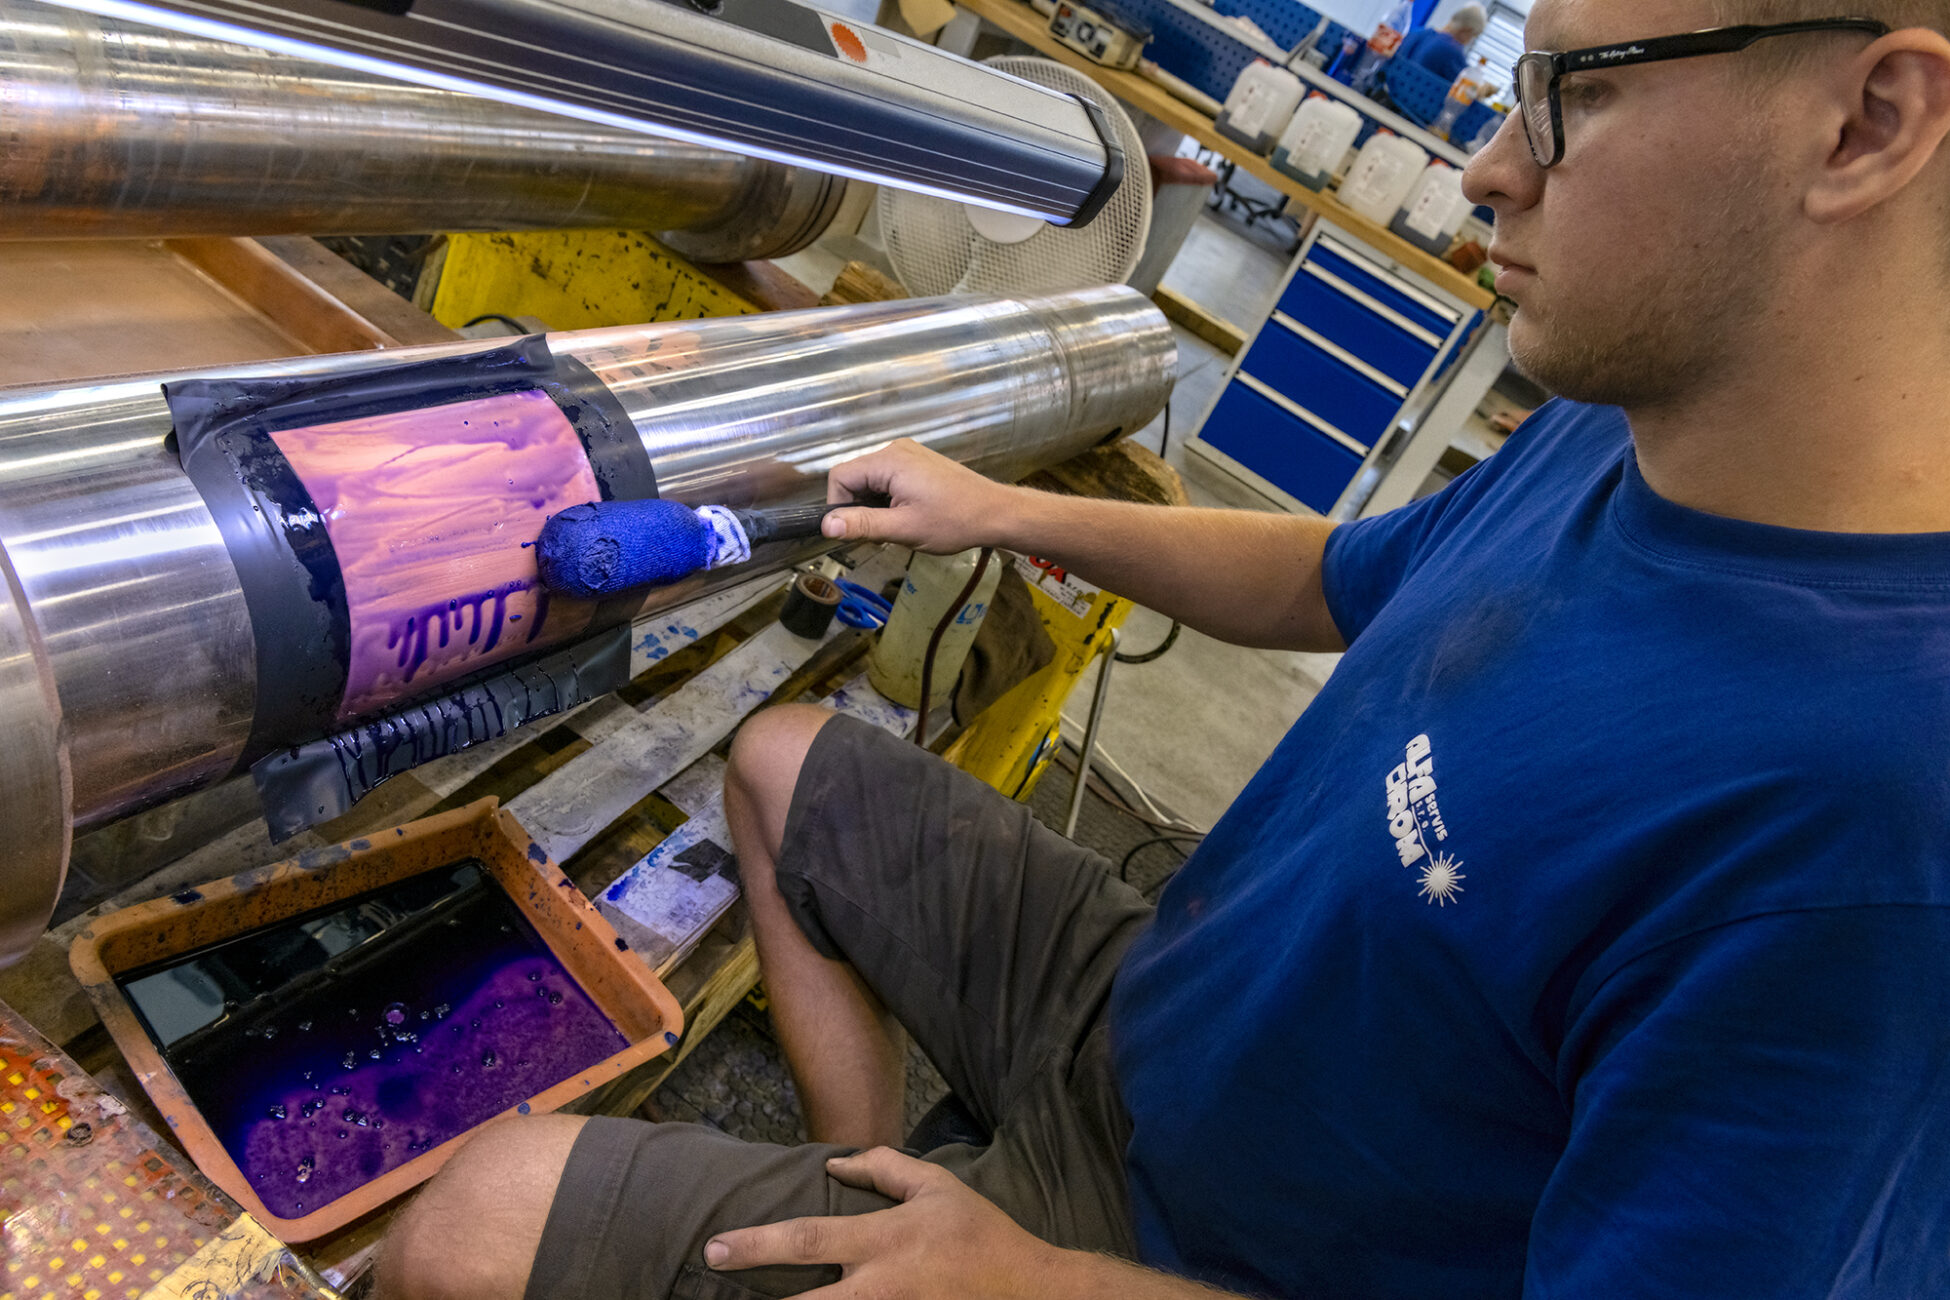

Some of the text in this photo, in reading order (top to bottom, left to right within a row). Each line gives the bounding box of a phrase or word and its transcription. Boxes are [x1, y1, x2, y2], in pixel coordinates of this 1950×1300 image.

[1405, 734, 1438, 804] ALFA
[1385, 762, 1426, 868] CHROM
[1425, 793, 1448, 841] servis
